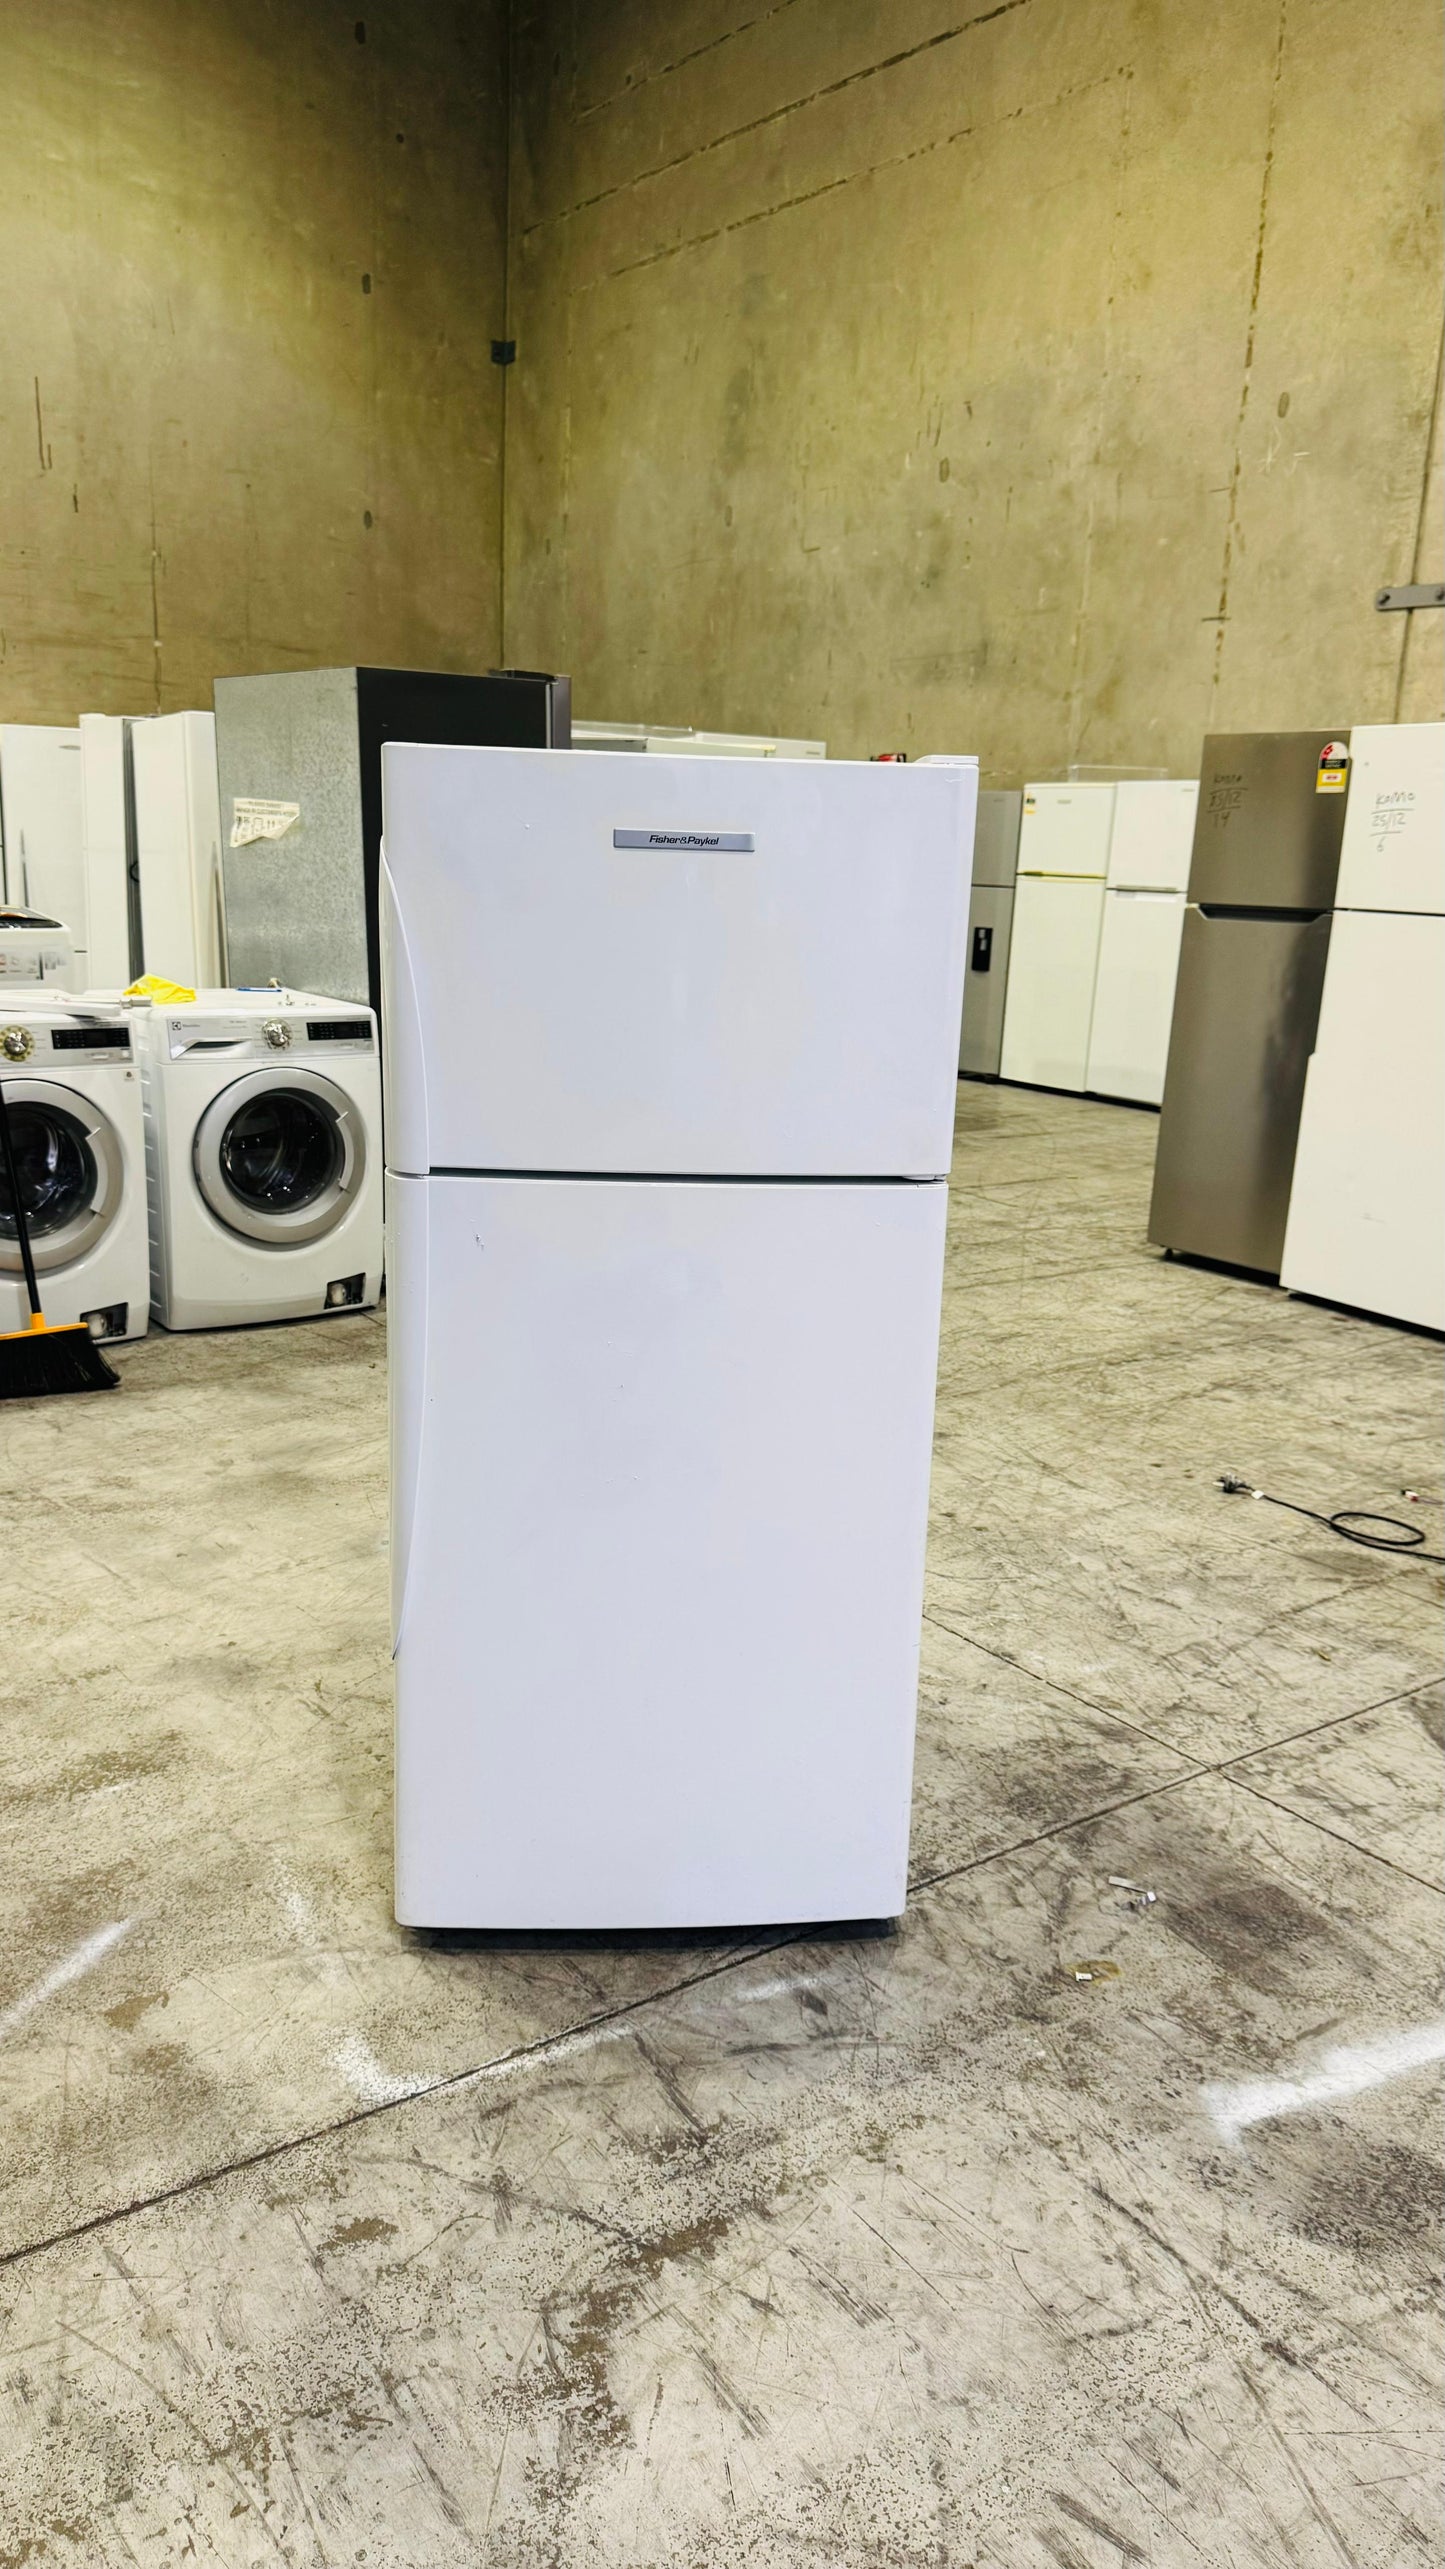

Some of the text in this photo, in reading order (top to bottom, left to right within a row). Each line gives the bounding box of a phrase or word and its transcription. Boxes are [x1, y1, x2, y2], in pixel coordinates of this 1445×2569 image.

[1372, 812, 1406, 830] 25/12
[649, 834, 720, 847] Fisher&Paykel
[1376, 836, 1385, 852] 6
